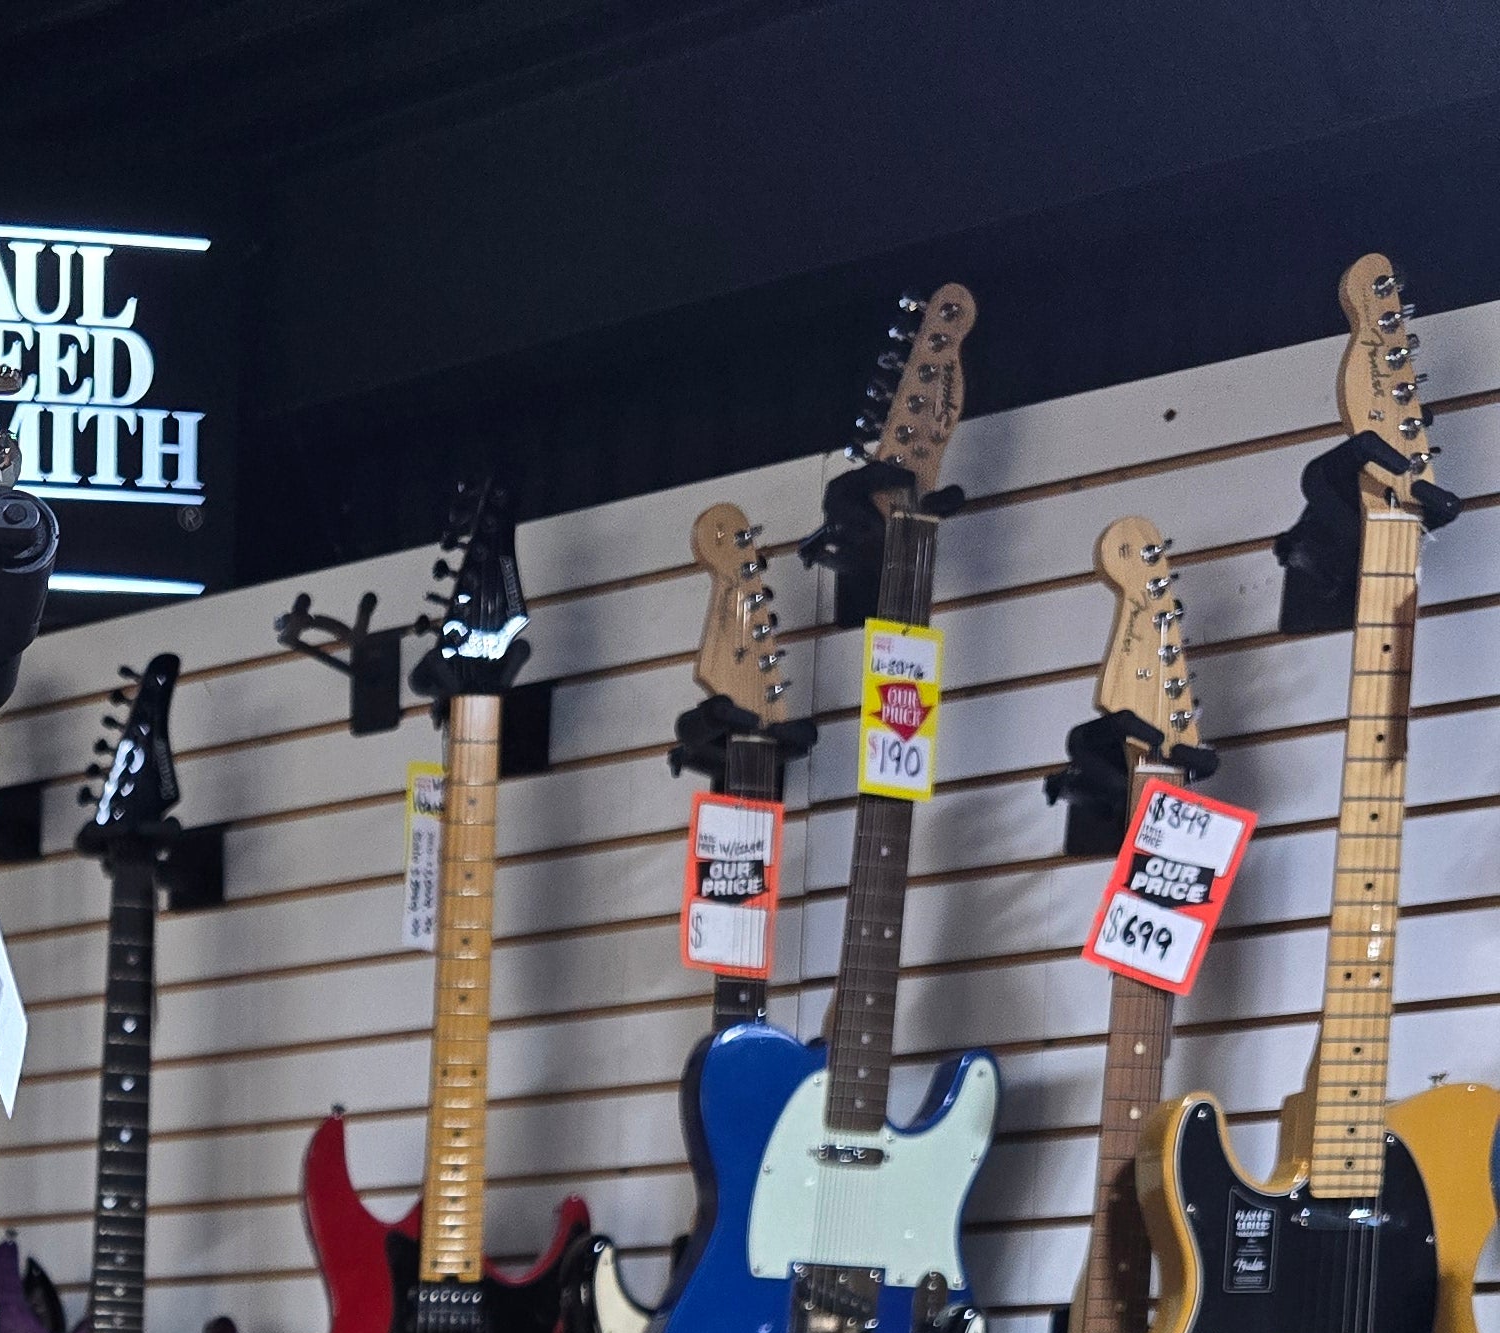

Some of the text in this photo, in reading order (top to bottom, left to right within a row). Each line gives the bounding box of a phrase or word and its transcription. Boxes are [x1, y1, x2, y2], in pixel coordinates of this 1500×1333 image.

[709, 861, 756, 880] OUR
[1145, 856, 1199, 884] OUR
[701, 878, 764, 898] PRICE
[1130, 871, 1208, 904] PRICE
